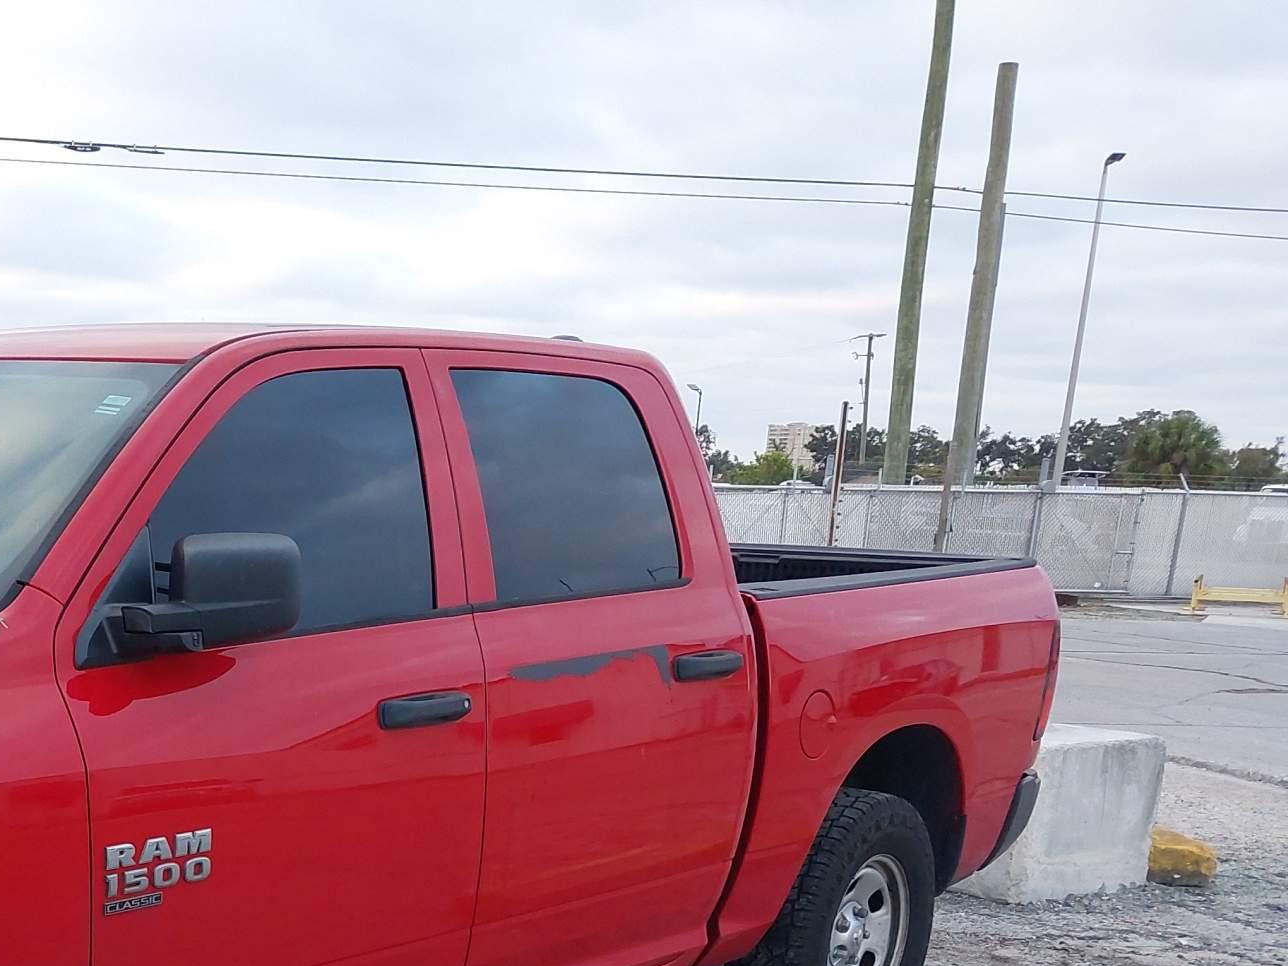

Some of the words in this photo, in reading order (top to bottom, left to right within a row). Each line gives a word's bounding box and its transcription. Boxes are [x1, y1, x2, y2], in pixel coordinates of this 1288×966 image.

[106, 828, 212, 871] RAM
[106, 857, 212, 897] 1500
[107, 894, 161, 914] CLASSIC
